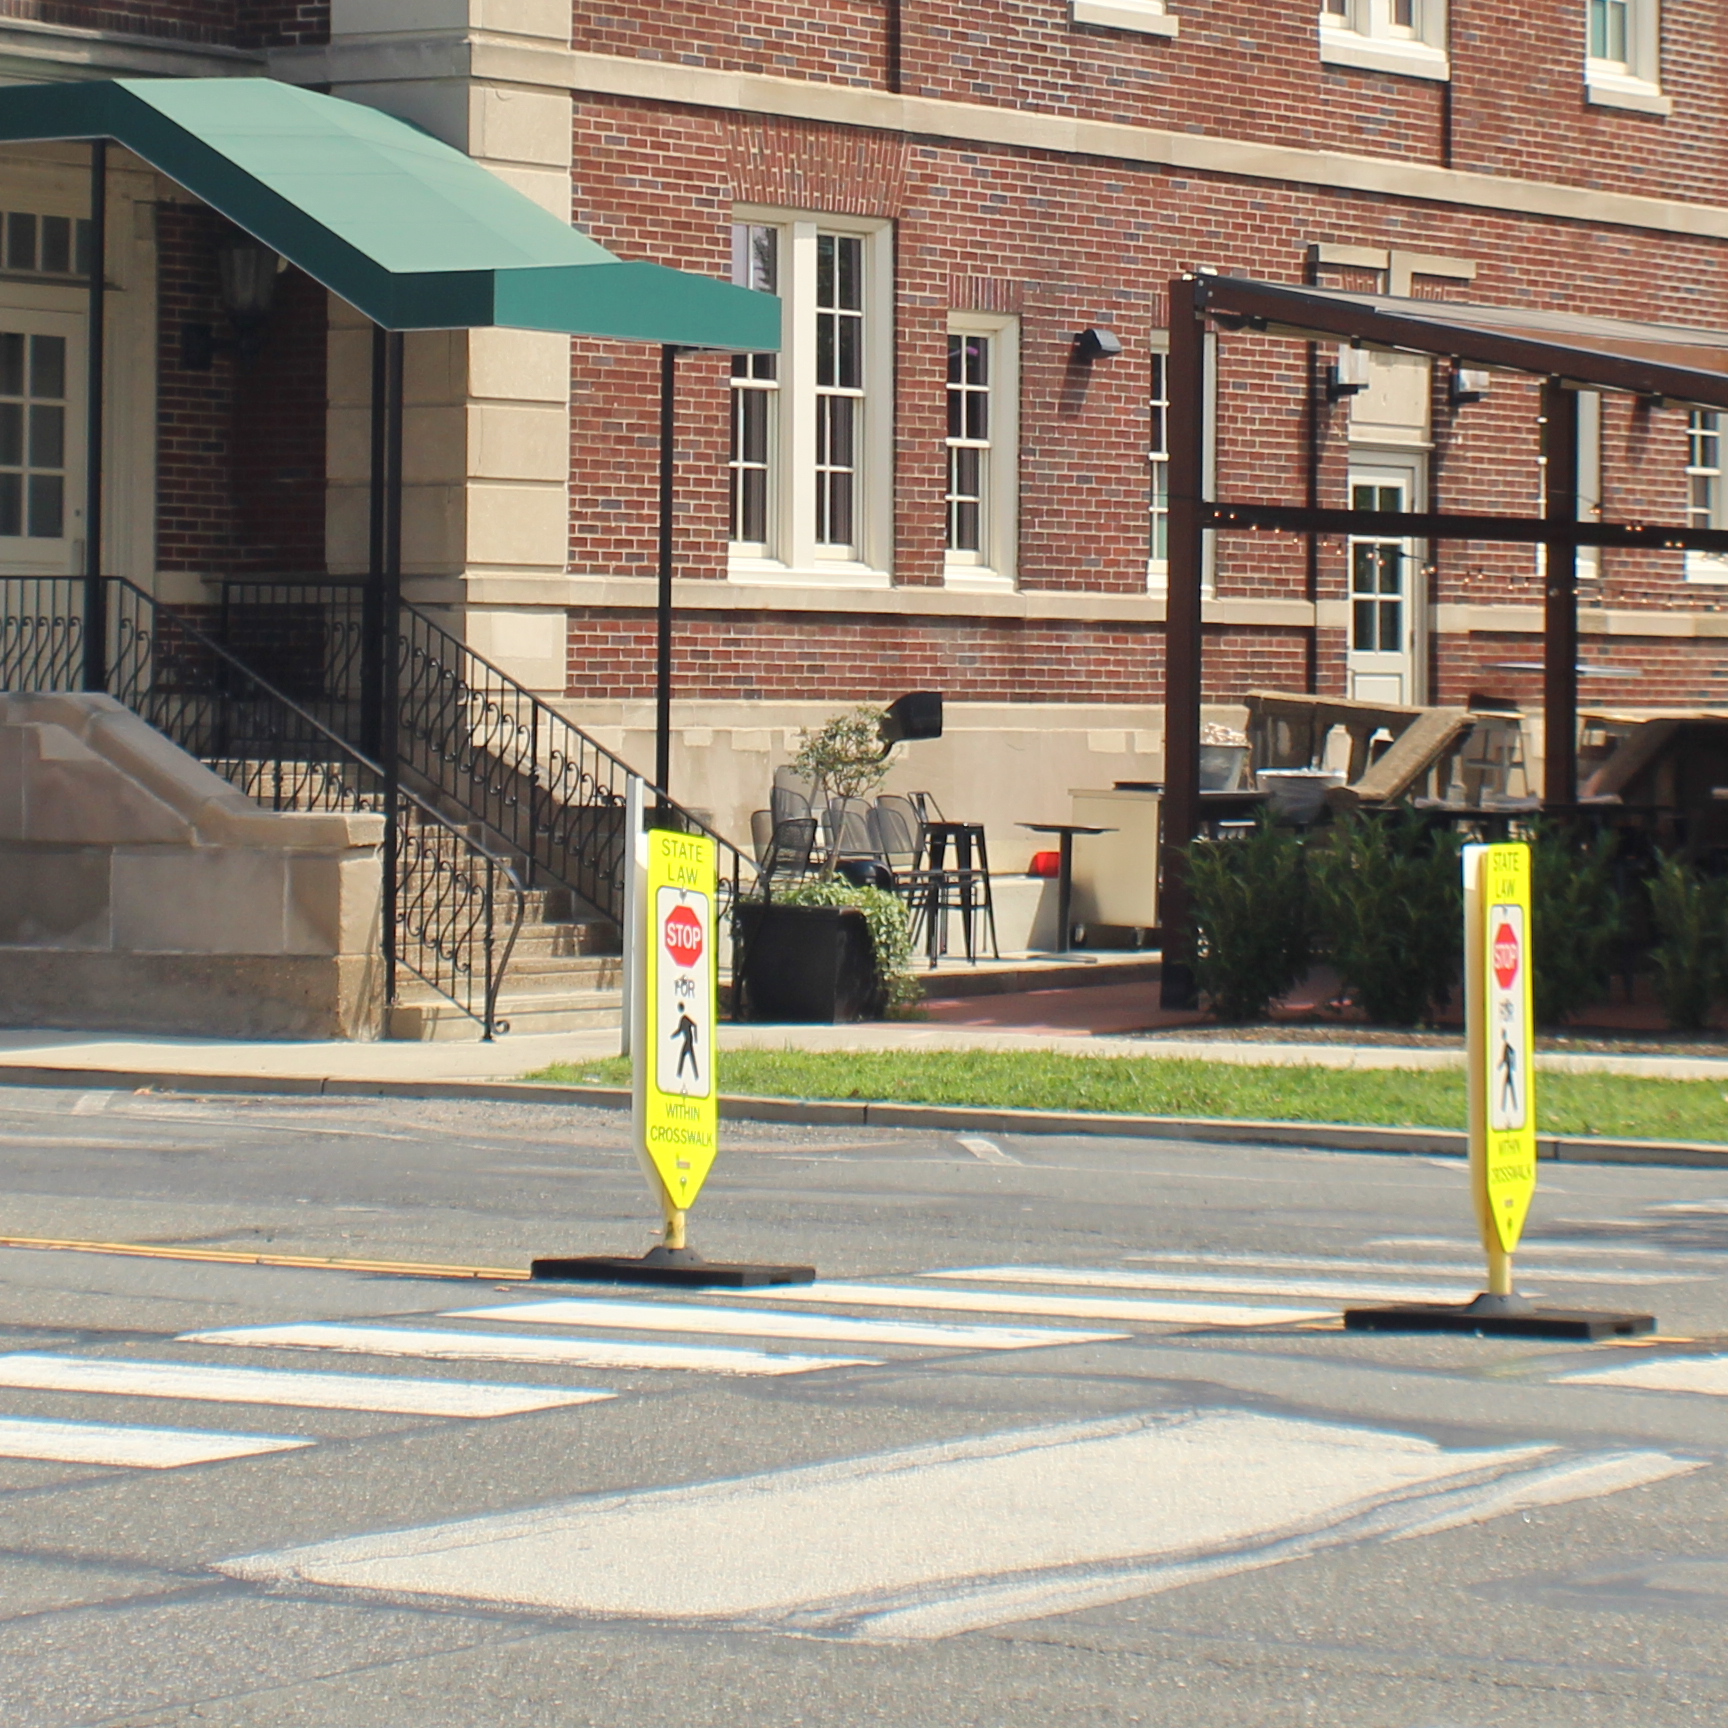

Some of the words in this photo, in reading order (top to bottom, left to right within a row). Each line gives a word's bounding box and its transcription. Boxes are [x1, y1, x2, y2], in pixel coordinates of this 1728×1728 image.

[661, 837, 704, 863] STATE
[1493, 851, 1519, 872] STATE
[667, 862, 698, 886] LAW
[1495, 877, 1516, 899] LAW
[666, 922, 701, 950] STOP
[1494, 943, 1518, 970] STOP
[674, 977, 695, 999] FOR
[665, 1101, 700, 1121] WITHIN
[650, 1124, 713, 1147] CROSSWALK
